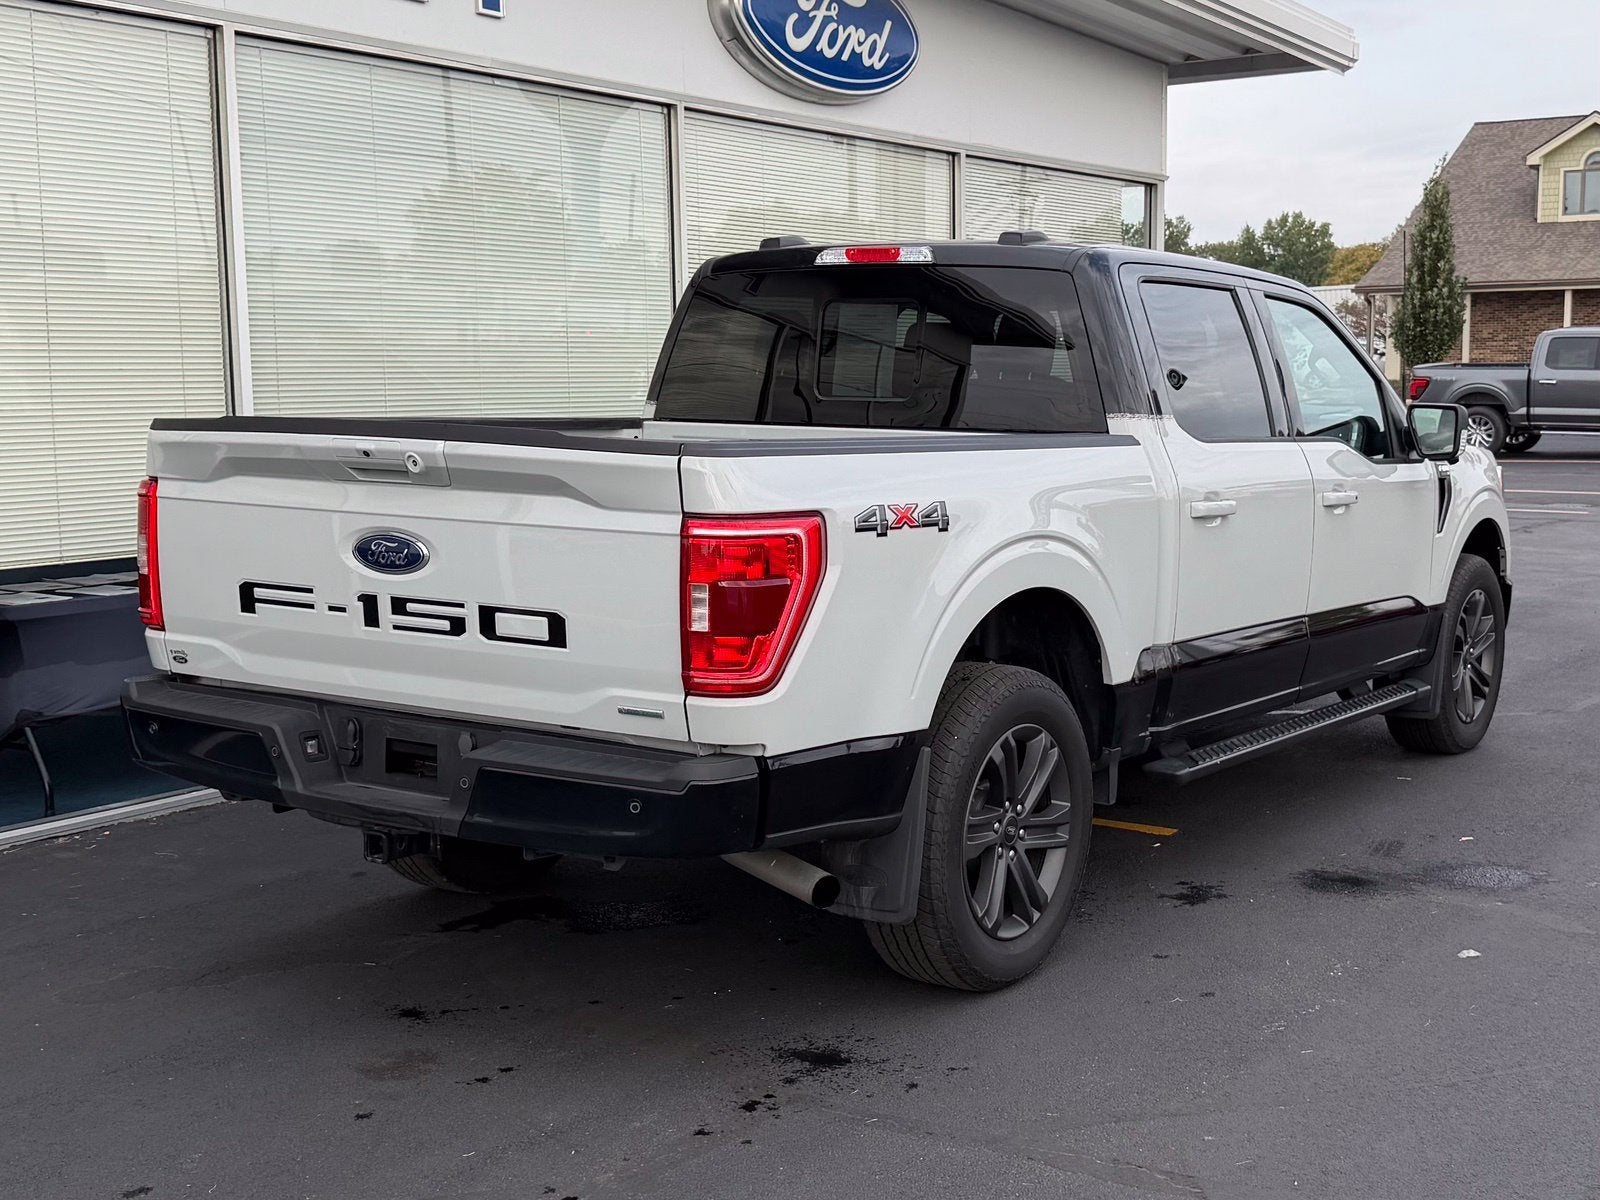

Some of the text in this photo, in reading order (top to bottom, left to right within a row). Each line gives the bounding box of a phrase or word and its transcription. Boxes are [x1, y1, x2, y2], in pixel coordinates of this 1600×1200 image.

[785, 0, 892, 70] Ford
[367, 540, 409, 564] Ford
[238, 579, 568, 650] F-150
